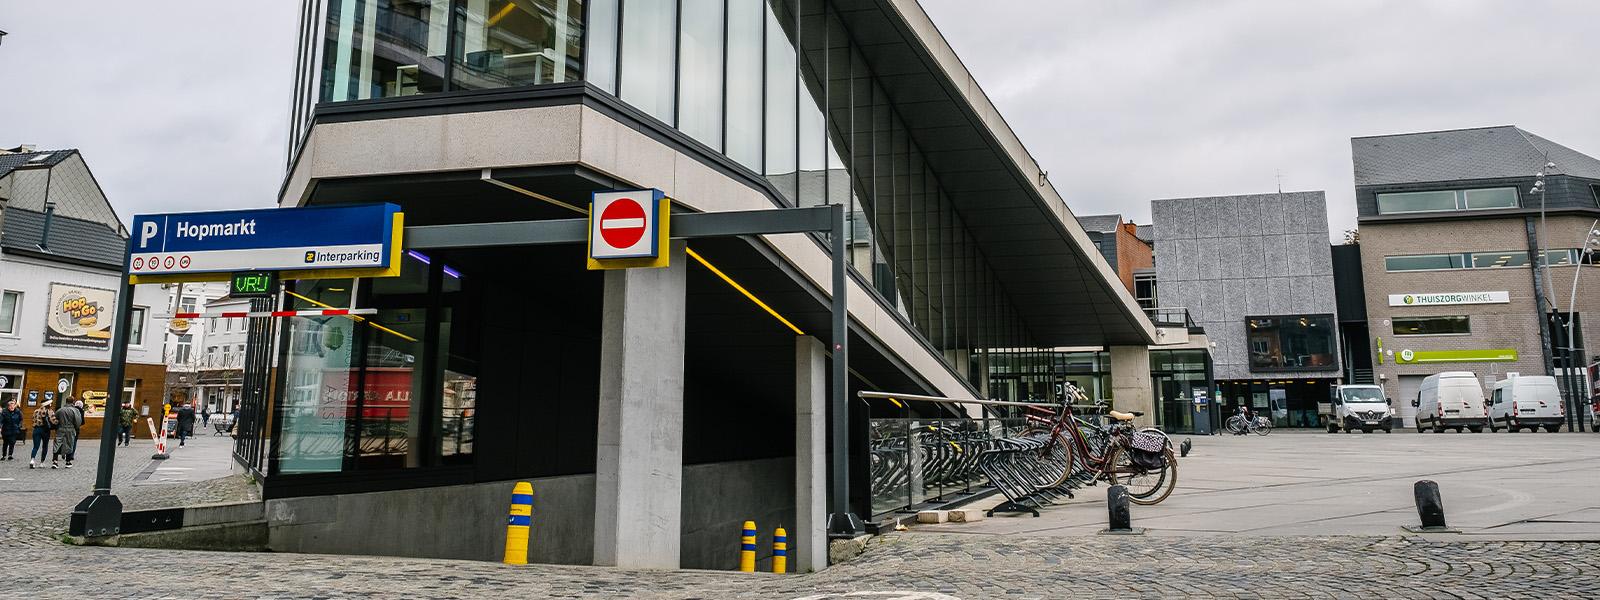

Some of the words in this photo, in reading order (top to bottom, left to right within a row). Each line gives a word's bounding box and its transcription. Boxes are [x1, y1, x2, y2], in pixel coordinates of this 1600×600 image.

[140, 221, 158, 249] P
[176, 219, 256, 241] Hopmarkt
[316, 249, 380, 262] Interparking
[63, 297, 86, 313] Hop
[1416, 293, 1493, 303] THUISZORGWINKEL
[81, 304, 97, 317] Go
[322, 384, 337, 426] AALST
